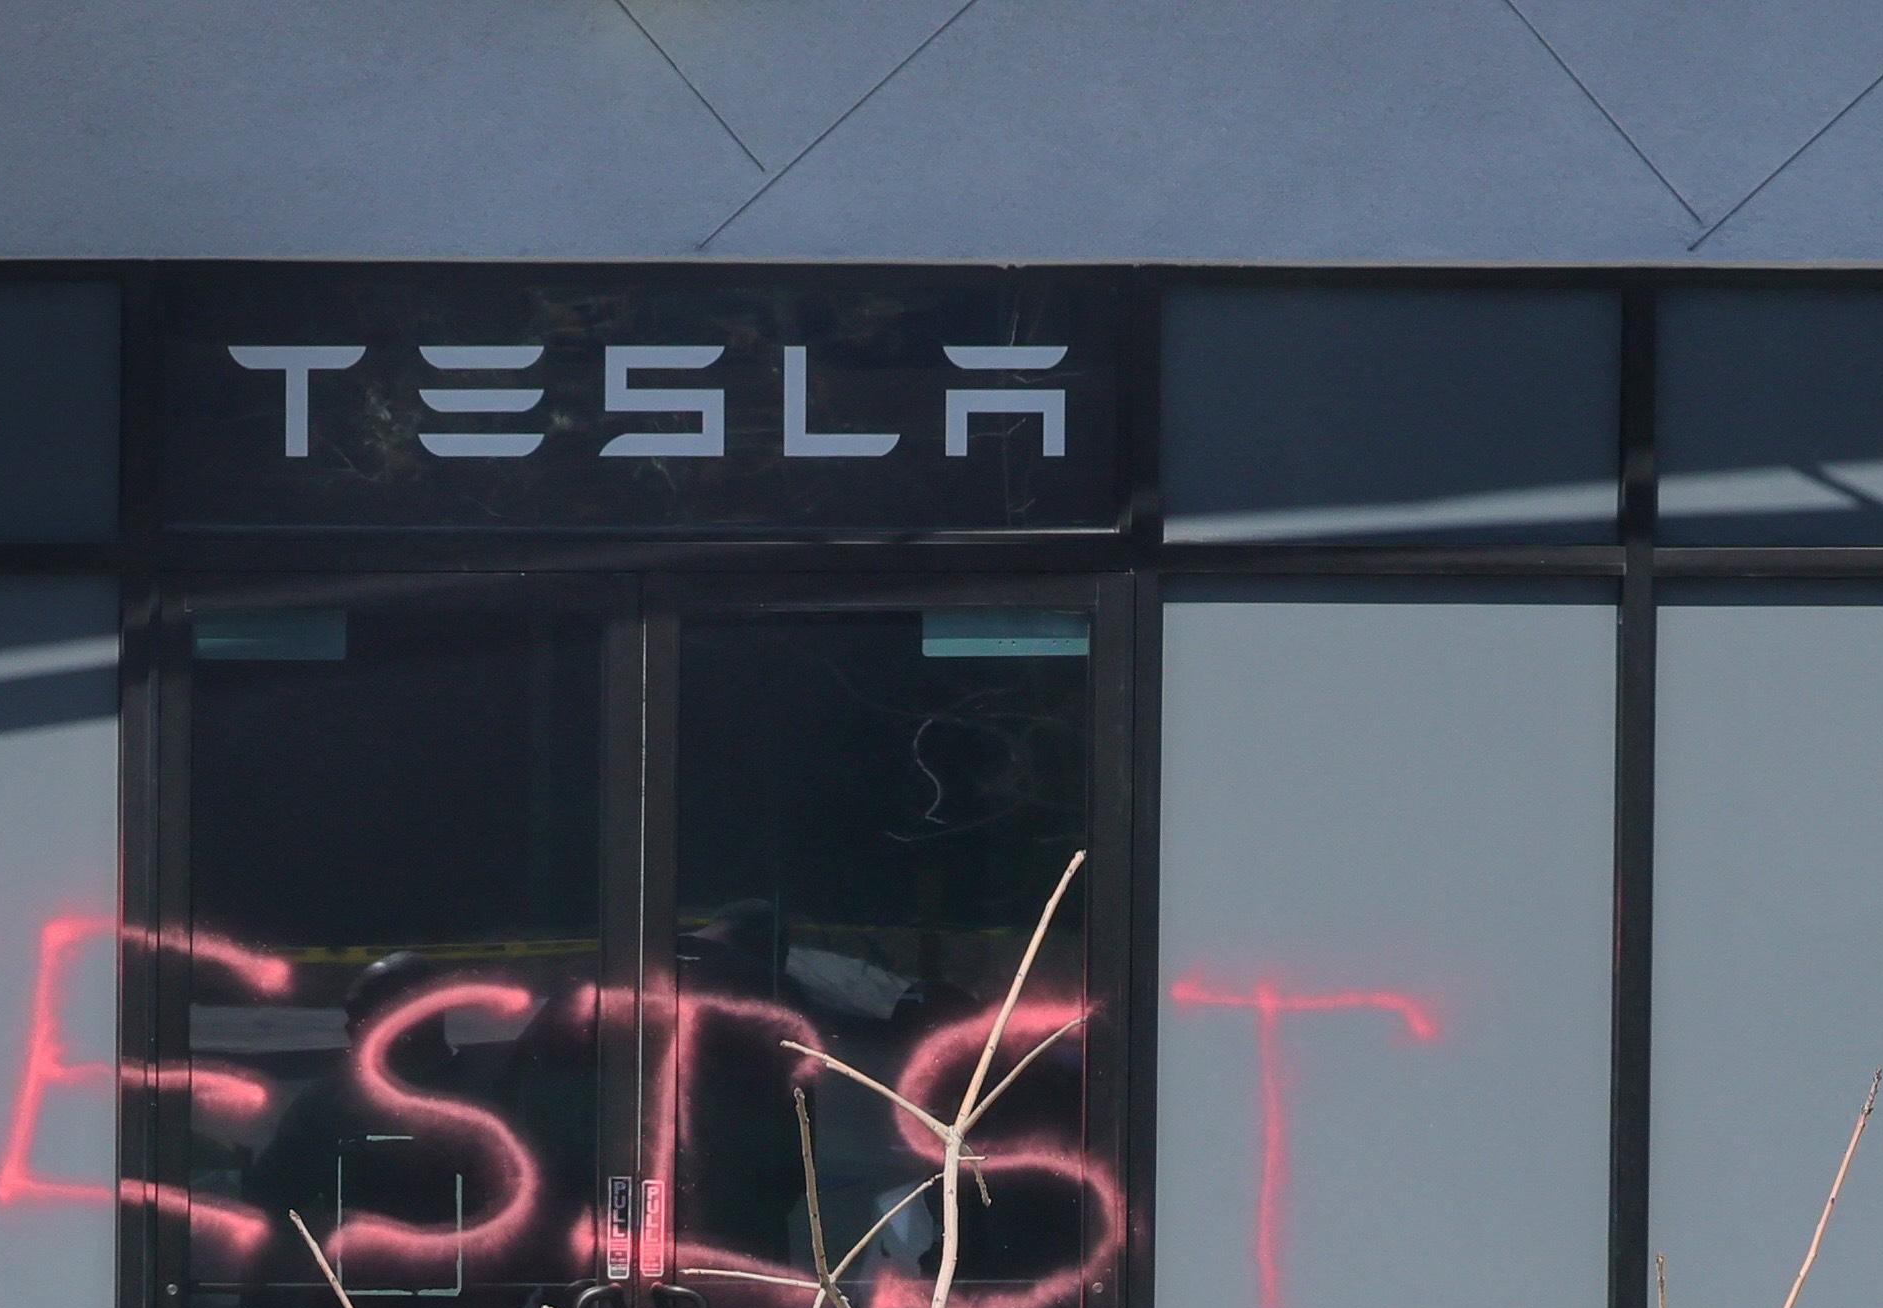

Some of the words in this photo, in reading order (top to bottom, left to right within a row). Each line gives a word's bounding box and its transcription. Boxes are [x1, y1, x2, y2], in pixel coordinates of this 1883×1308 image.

[227, 345, 1069, 457] TESLA
[613, 1181, 627, 1238] PULL
[645, 1186, 660, 1242] PULL
